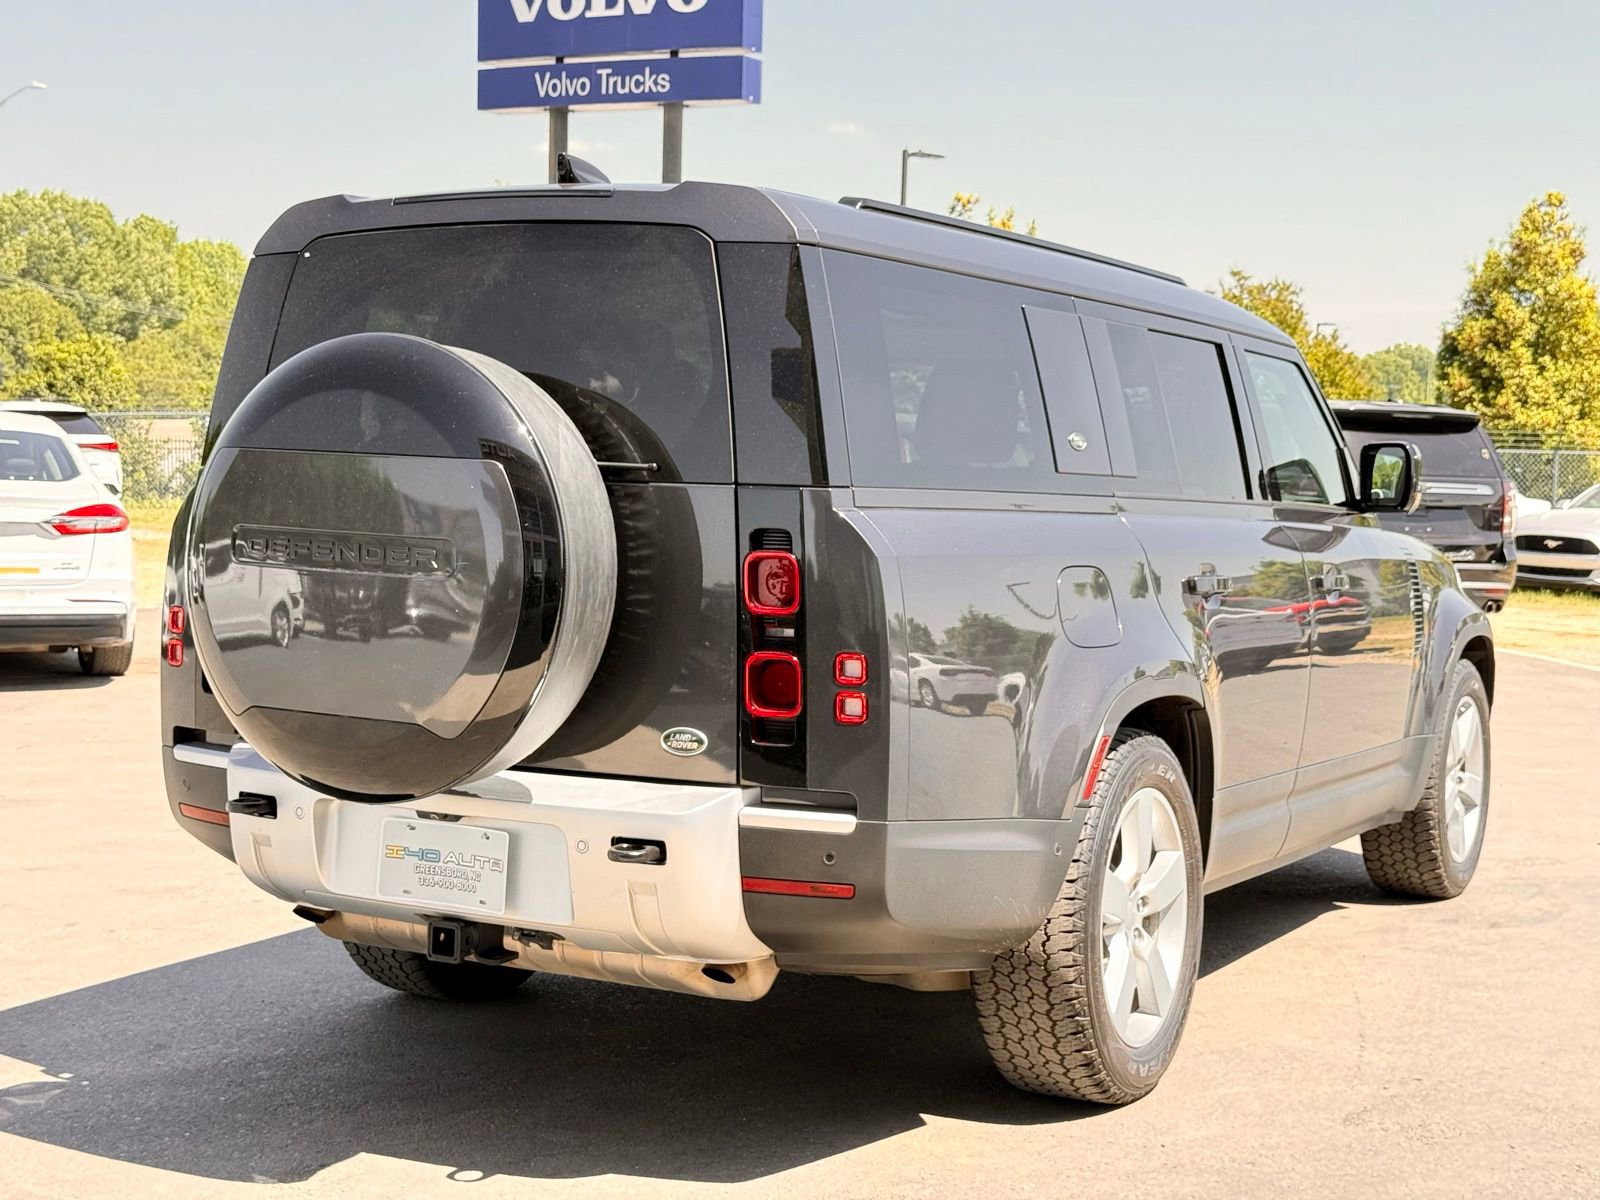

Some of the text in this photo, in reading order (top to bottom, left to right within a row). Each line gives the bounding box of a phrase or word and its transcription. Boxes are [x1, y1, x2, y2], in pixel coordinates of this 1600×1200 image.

[534, 66, 671, 98] Volvo Trucks
[249, 537, 438, 569] DEFENDER
[670, 733, 692, 741] LAND
[671, 741, 699, 749] ROVER
